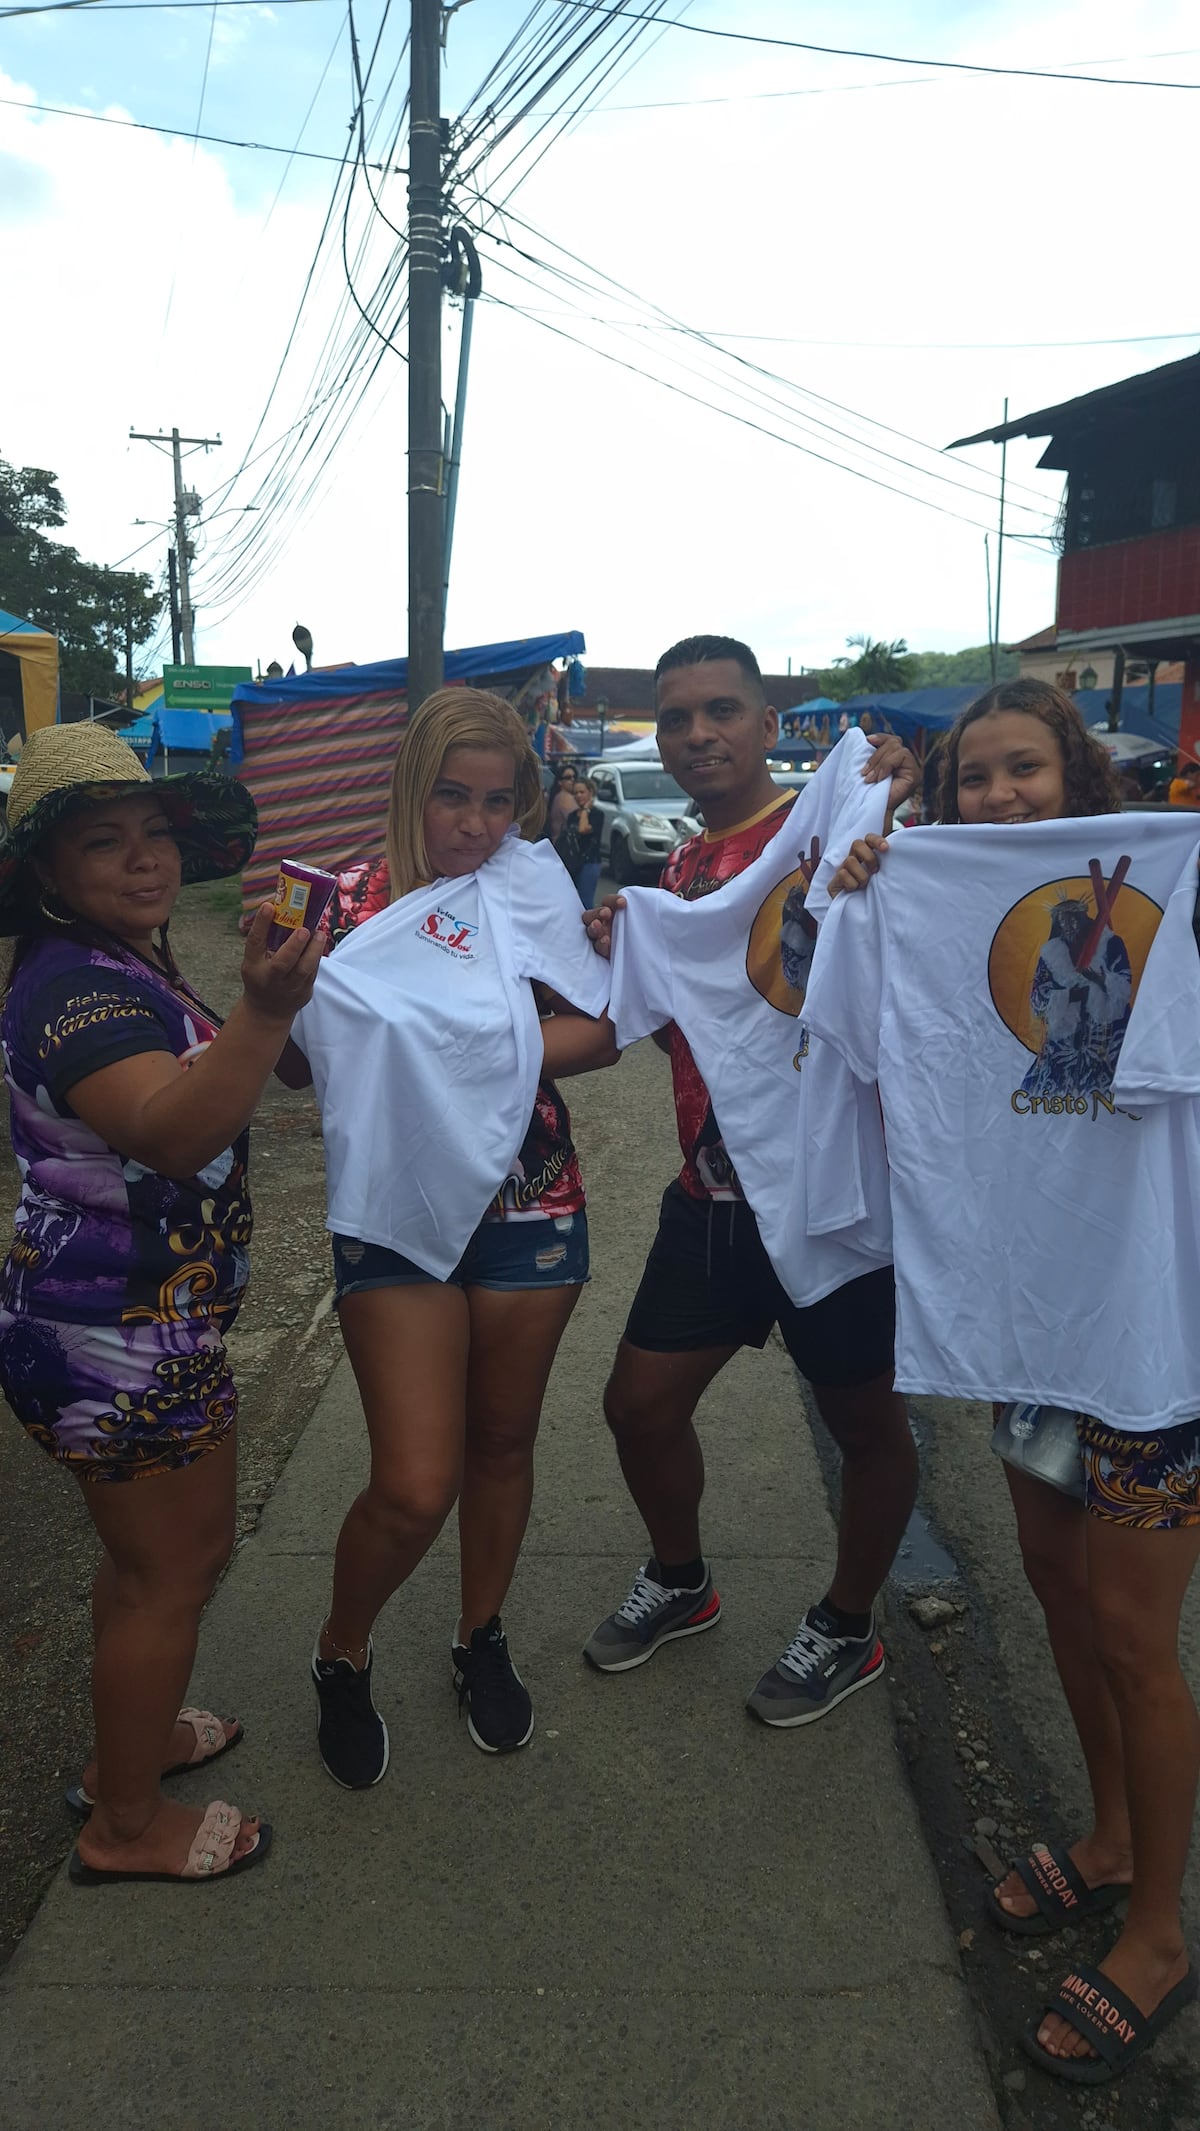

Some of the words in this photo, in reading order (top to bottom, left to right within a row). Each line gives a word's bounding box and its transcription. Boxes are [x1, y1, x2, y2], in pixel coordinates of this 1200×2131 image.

[437, 906, 456, 921] Velas
[420, 914, 446, 942] San
[447, 926, 472, 952] José
[450, 950, 458, 958] tu
[1011, 1089, 1088, 1115] Cristo
[1076, 2001, 1109, 2034] LOVERS
